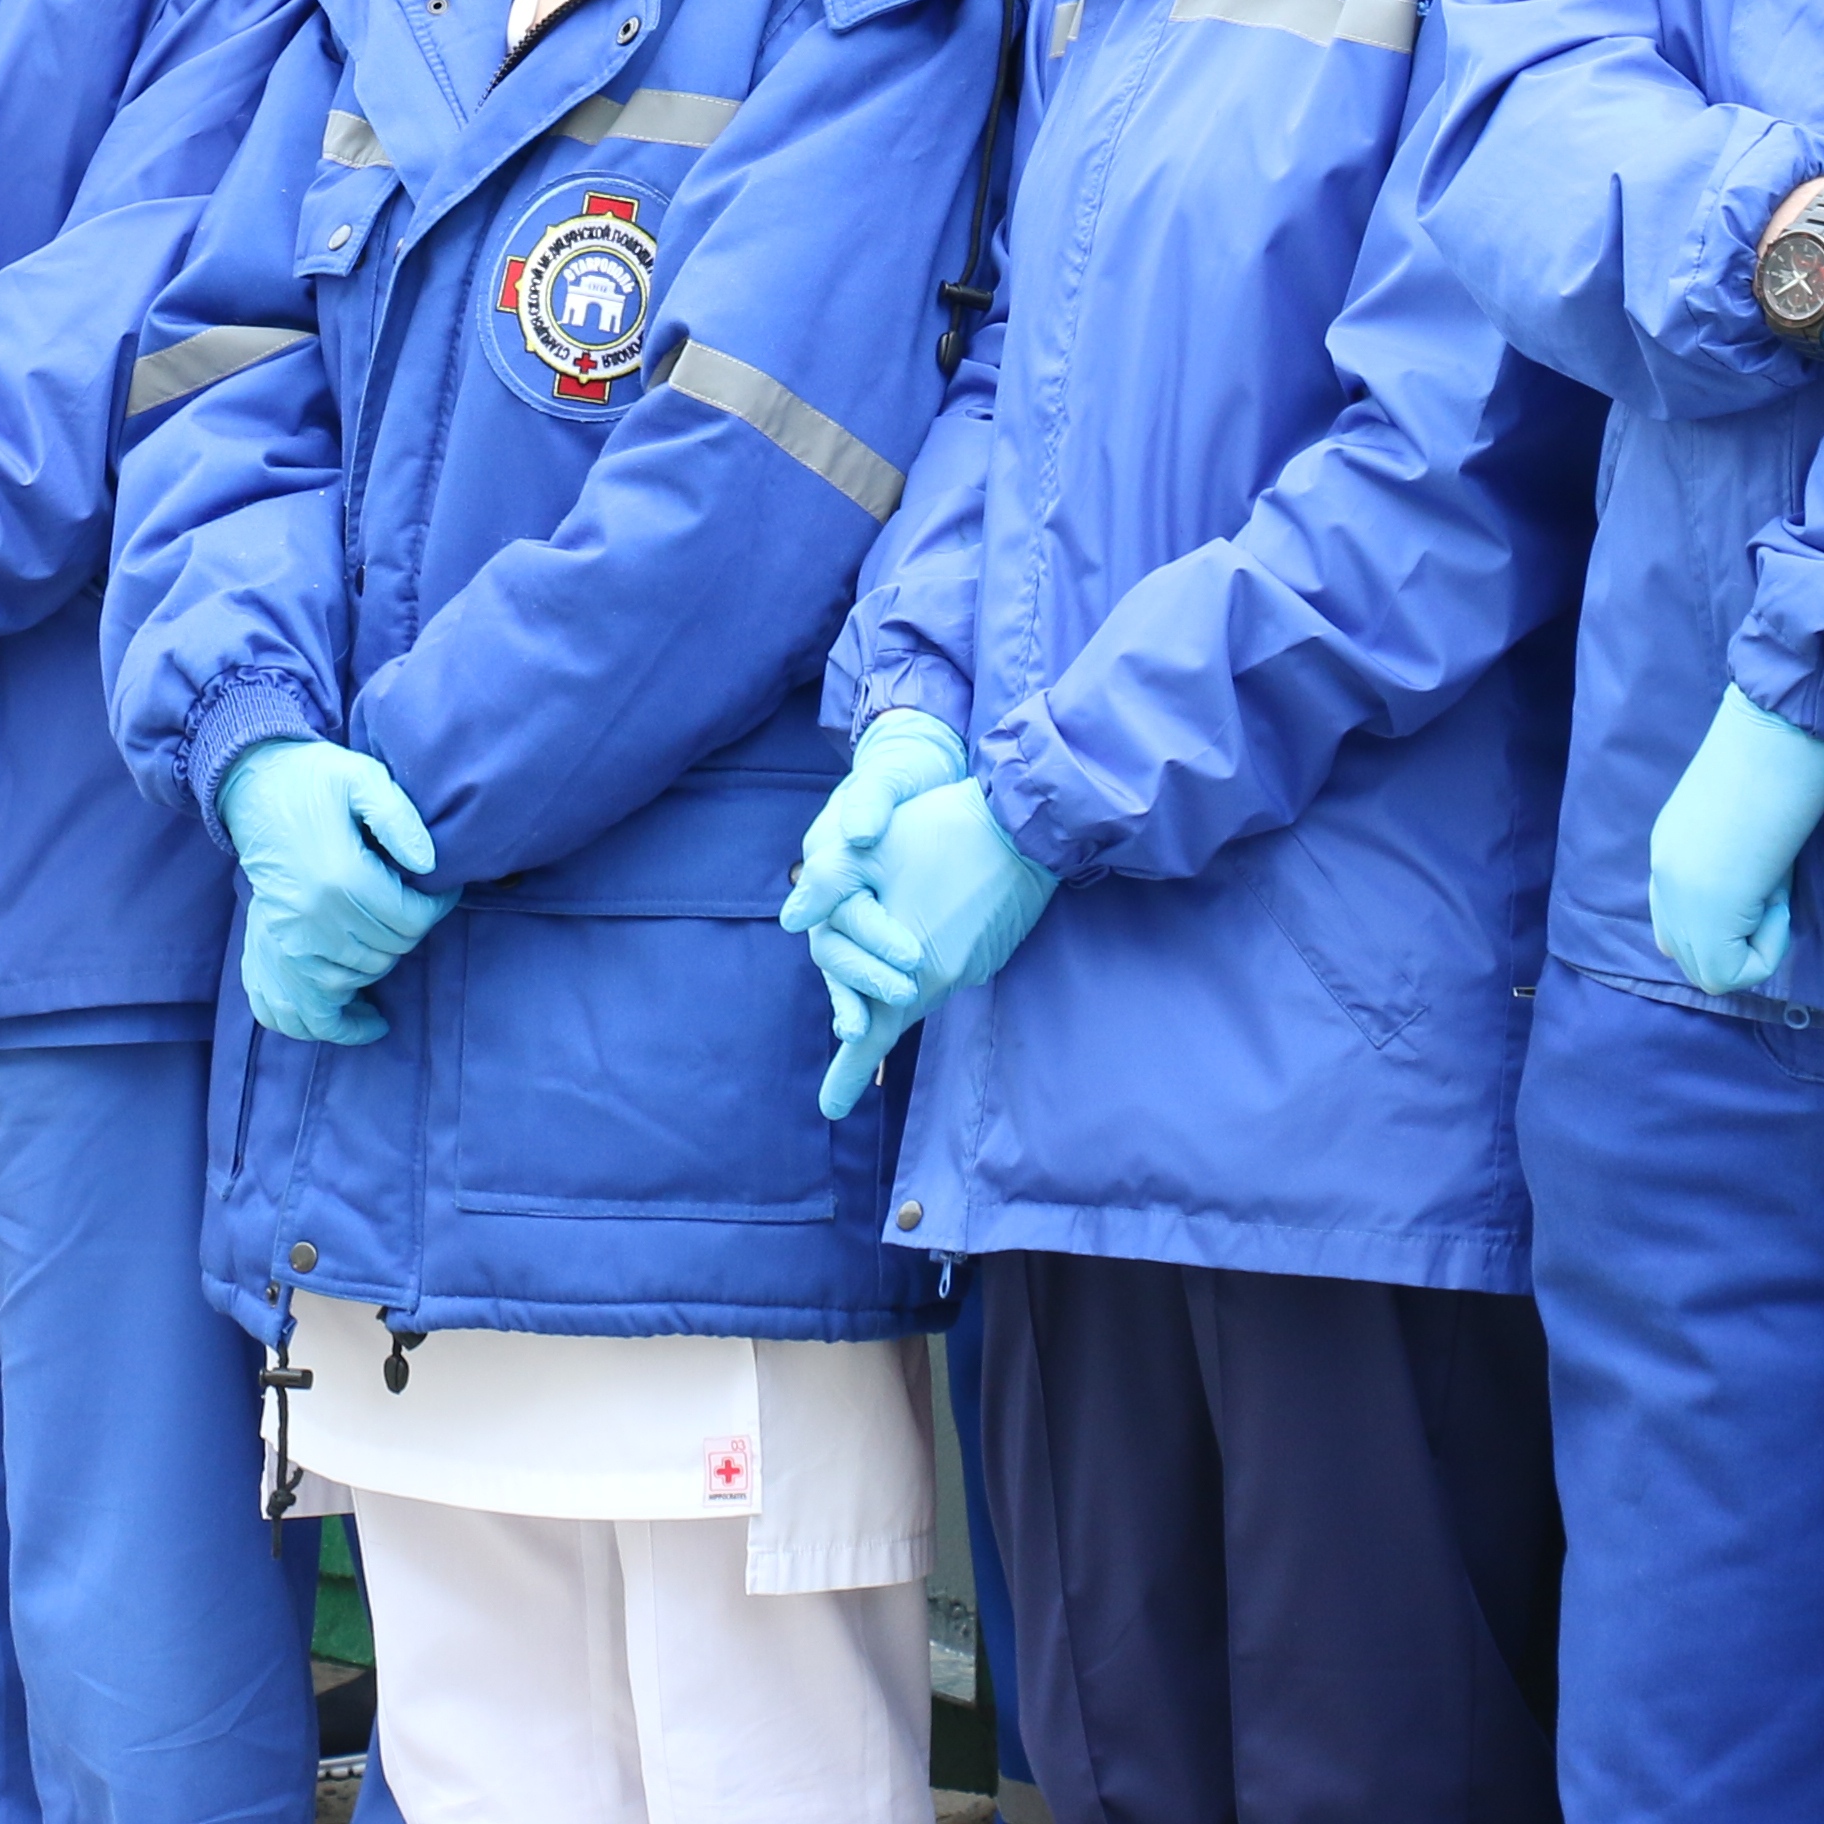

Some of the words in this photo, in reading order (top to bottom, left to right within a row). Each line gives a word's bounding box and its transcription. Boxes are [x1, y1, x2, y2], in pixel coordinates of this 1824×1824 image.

[528, 267, 544, 316] СКОРОЙ
[563, 257, 635, 293] СТАВРОПОЛЬ
[530, 315, 571, 360] СТАНЦИЯ
[731, 1439, 746, 1452] 03
